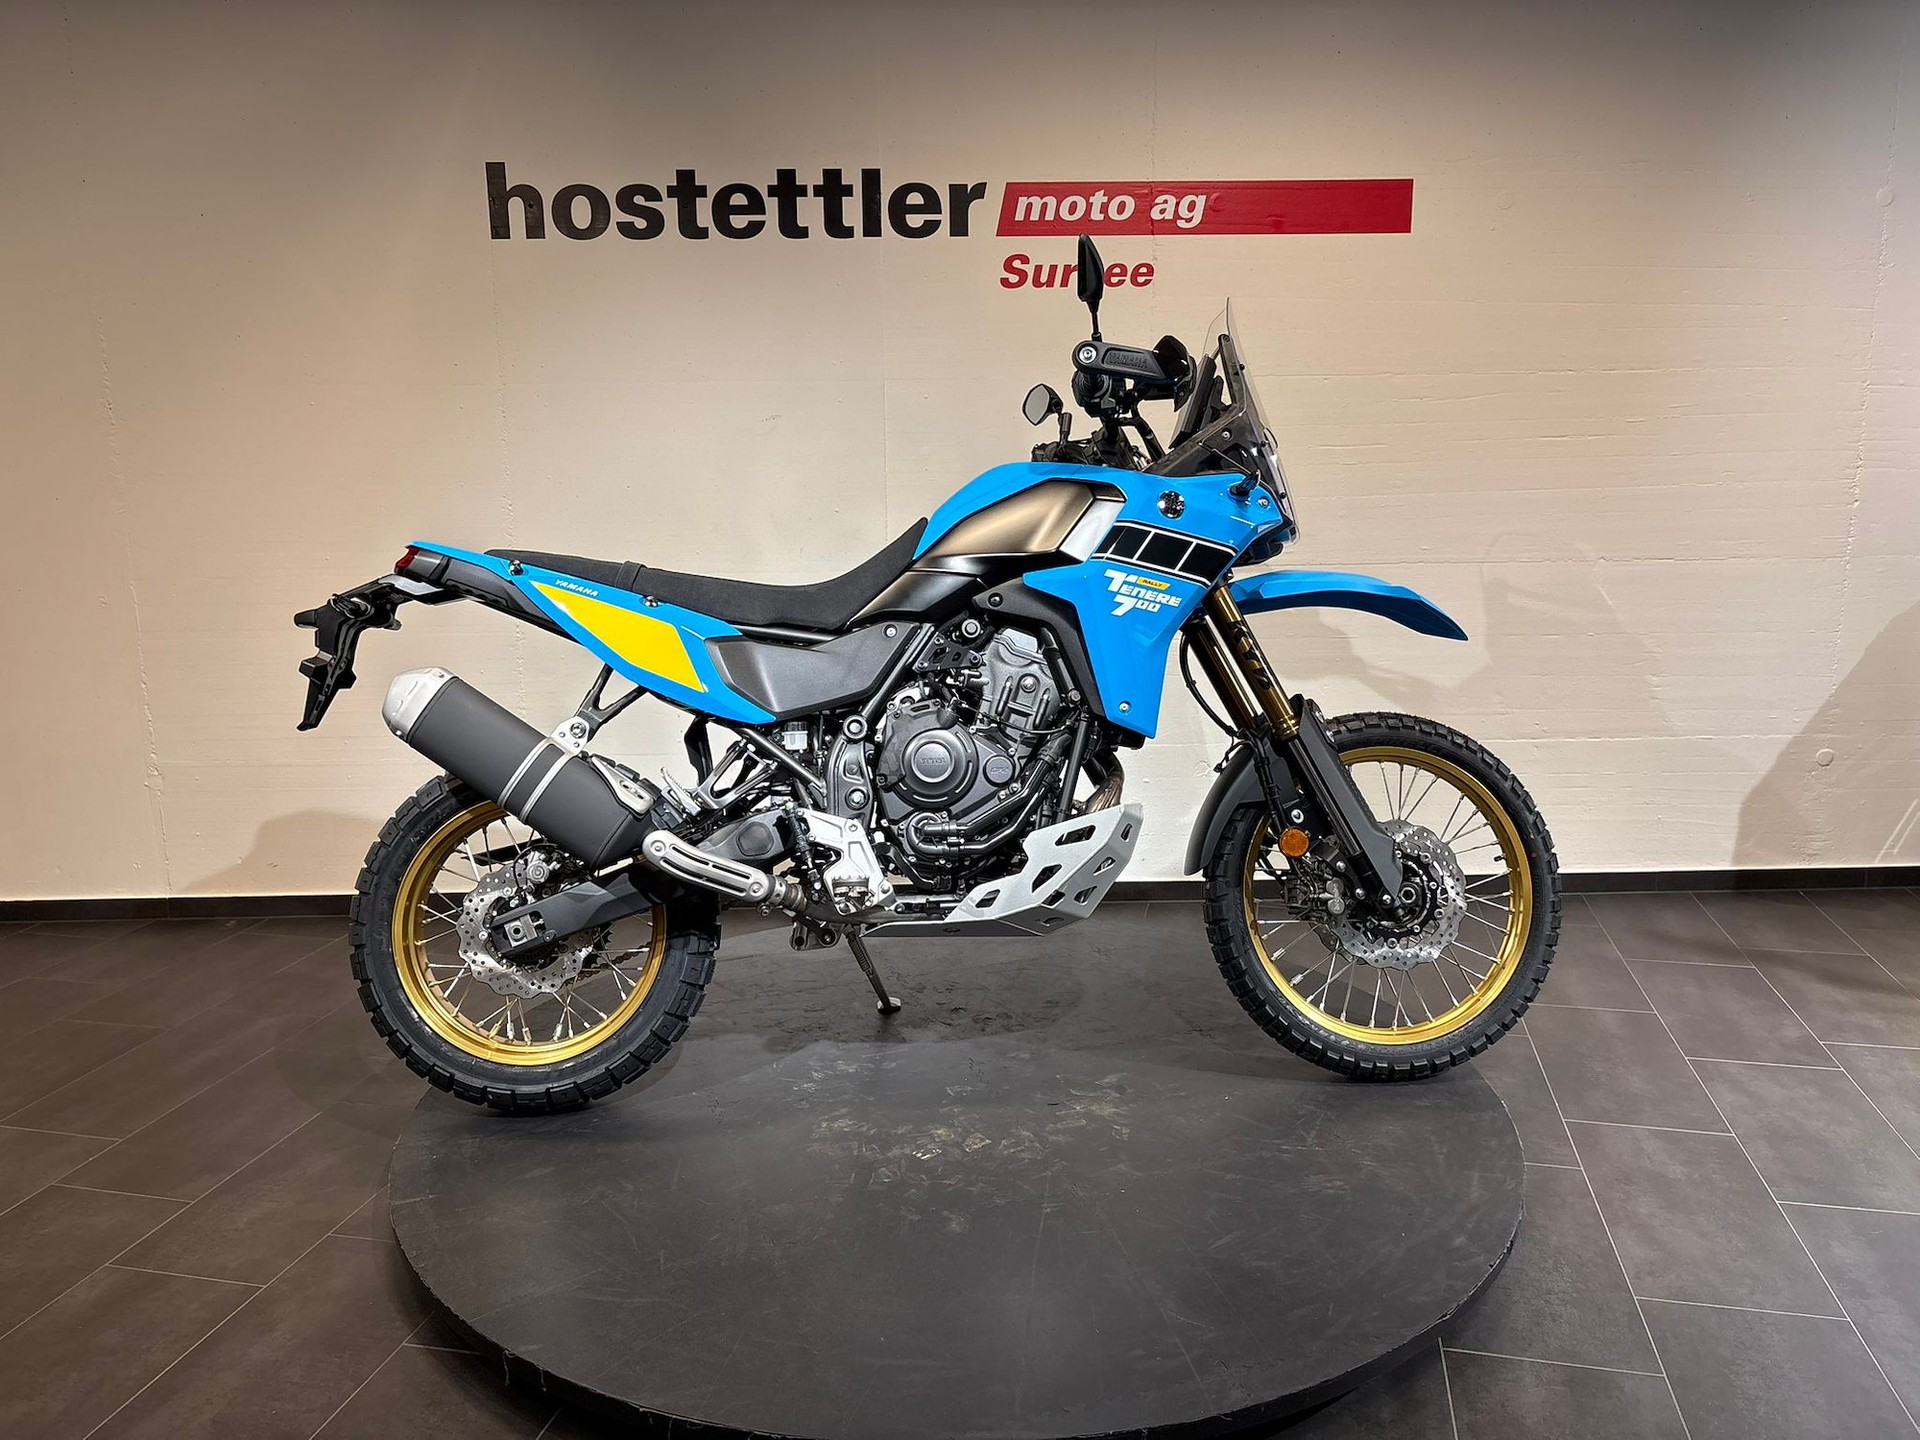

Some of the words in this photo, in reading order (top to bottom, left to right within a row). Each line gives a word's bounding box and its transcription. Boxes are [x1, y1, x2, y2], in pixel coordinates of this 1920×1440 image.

[485, 161, 988, 240] hostettler
[1014, 189, 1136, 221] moto
[1150, 194, 1207, 229] ag
[1000, 253, 1155, 289] Suree
[555, 579, 599, 597] YAMAHA
[1111, 594, 1161, 616] 700
